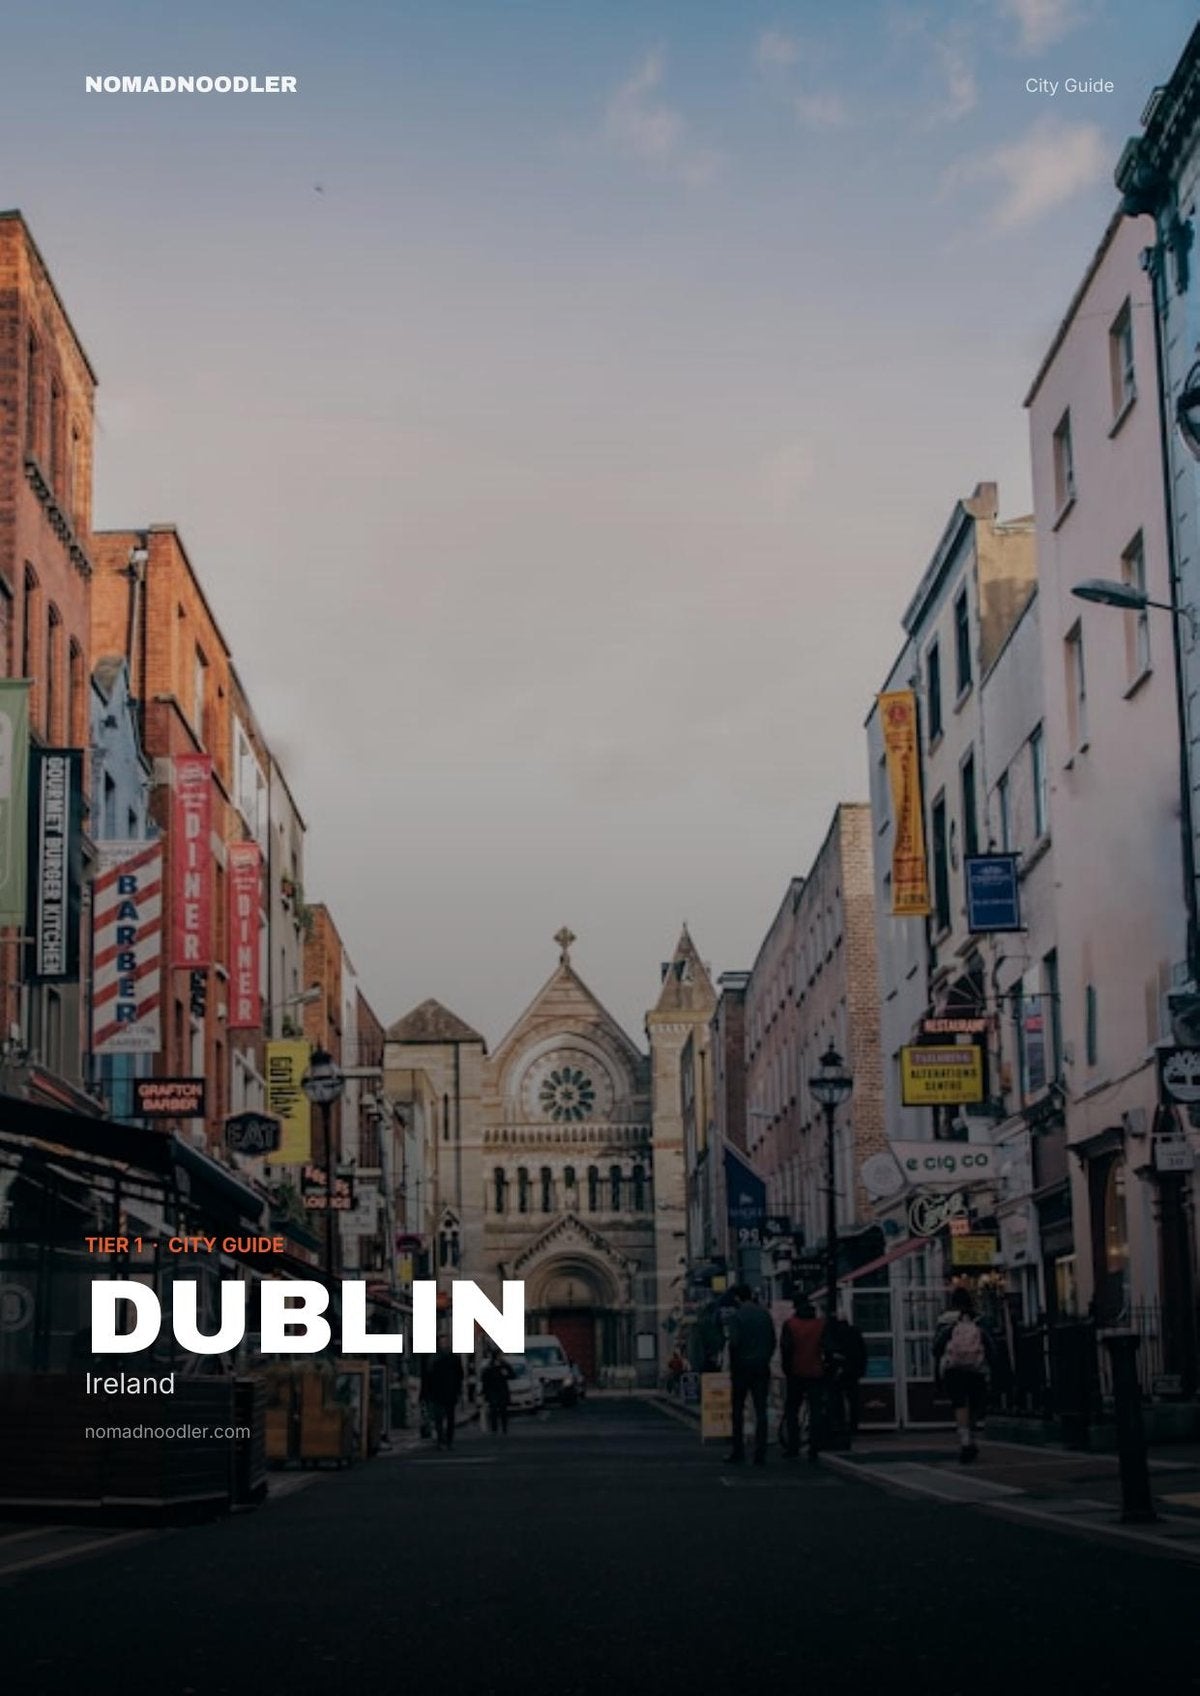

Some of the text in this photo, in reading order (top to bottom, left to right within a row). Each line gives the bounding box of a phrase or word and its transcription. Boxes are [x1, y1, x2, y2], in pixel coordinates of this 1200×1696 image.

[43, 756, 66, 975] GOURMET BURGER KITCHEN
[182, 813, 202, 961] DINER
[117, 875, 139, 1023] BARBER
[237, 895, 254, 1021] DINER
[138, 1083, 203, 1098] GRAFTON
[142, 1097, 198, 1111] BARBER
[227, 1118, 278, 1149] EAT
[906, 1152, 989, 1173] e cig co
